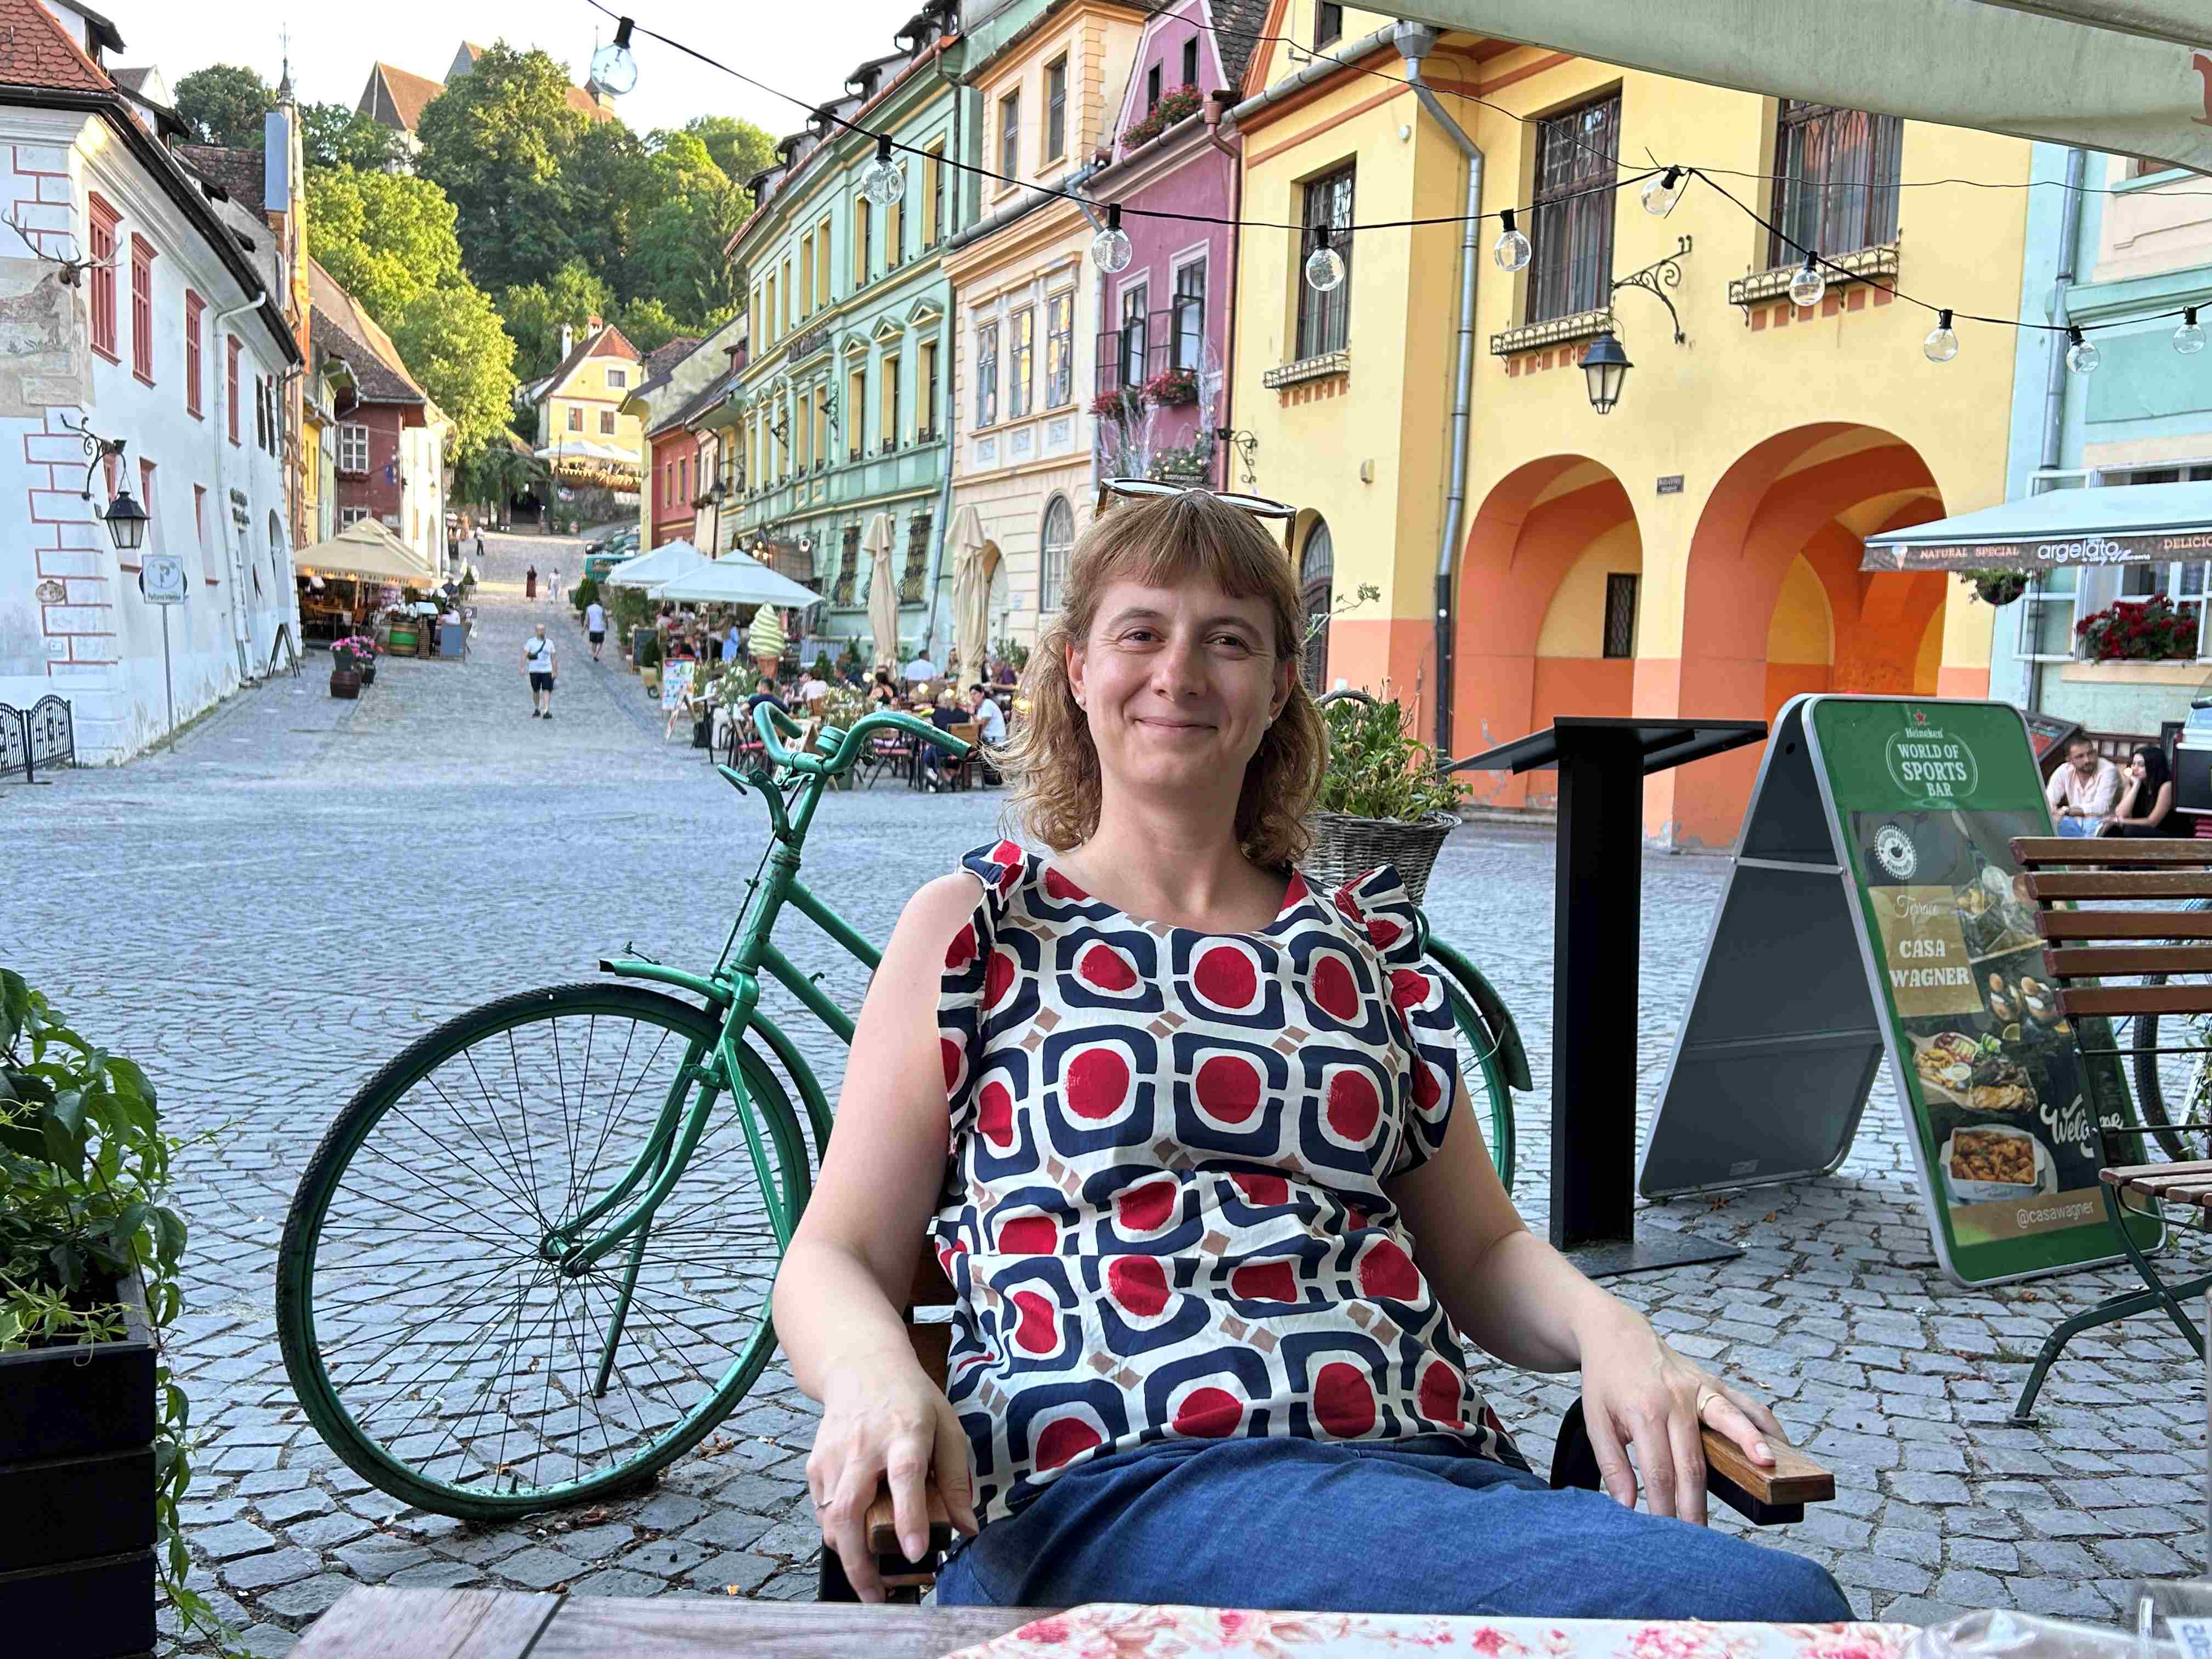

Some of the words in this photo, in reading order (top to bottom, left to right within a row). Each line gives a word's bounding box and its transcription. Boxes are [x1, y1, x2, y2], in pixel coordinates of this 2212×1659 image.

[1920, 547, 1967, 559] NATURAL
[1974, 545, 2019, 557] SPECIAL
[2038, 538, 2118, 562] argelato
[1905, 727, 1944, 738] Heineken
[1897, 743, 1942, 759] WORLD
[1944, 744, 1959, 759] OF
[1901, 761, 1967, 781] SPORTS
[1926, 782, 1954, 797] BAR
[1899, 939, 1946, 958] CASA
[1889, 967, 1971, 988] WAGNER
[2040, 1093, 2124, 1158] Welcme
[2017, 1201, 2094, 1229] @casawagner
